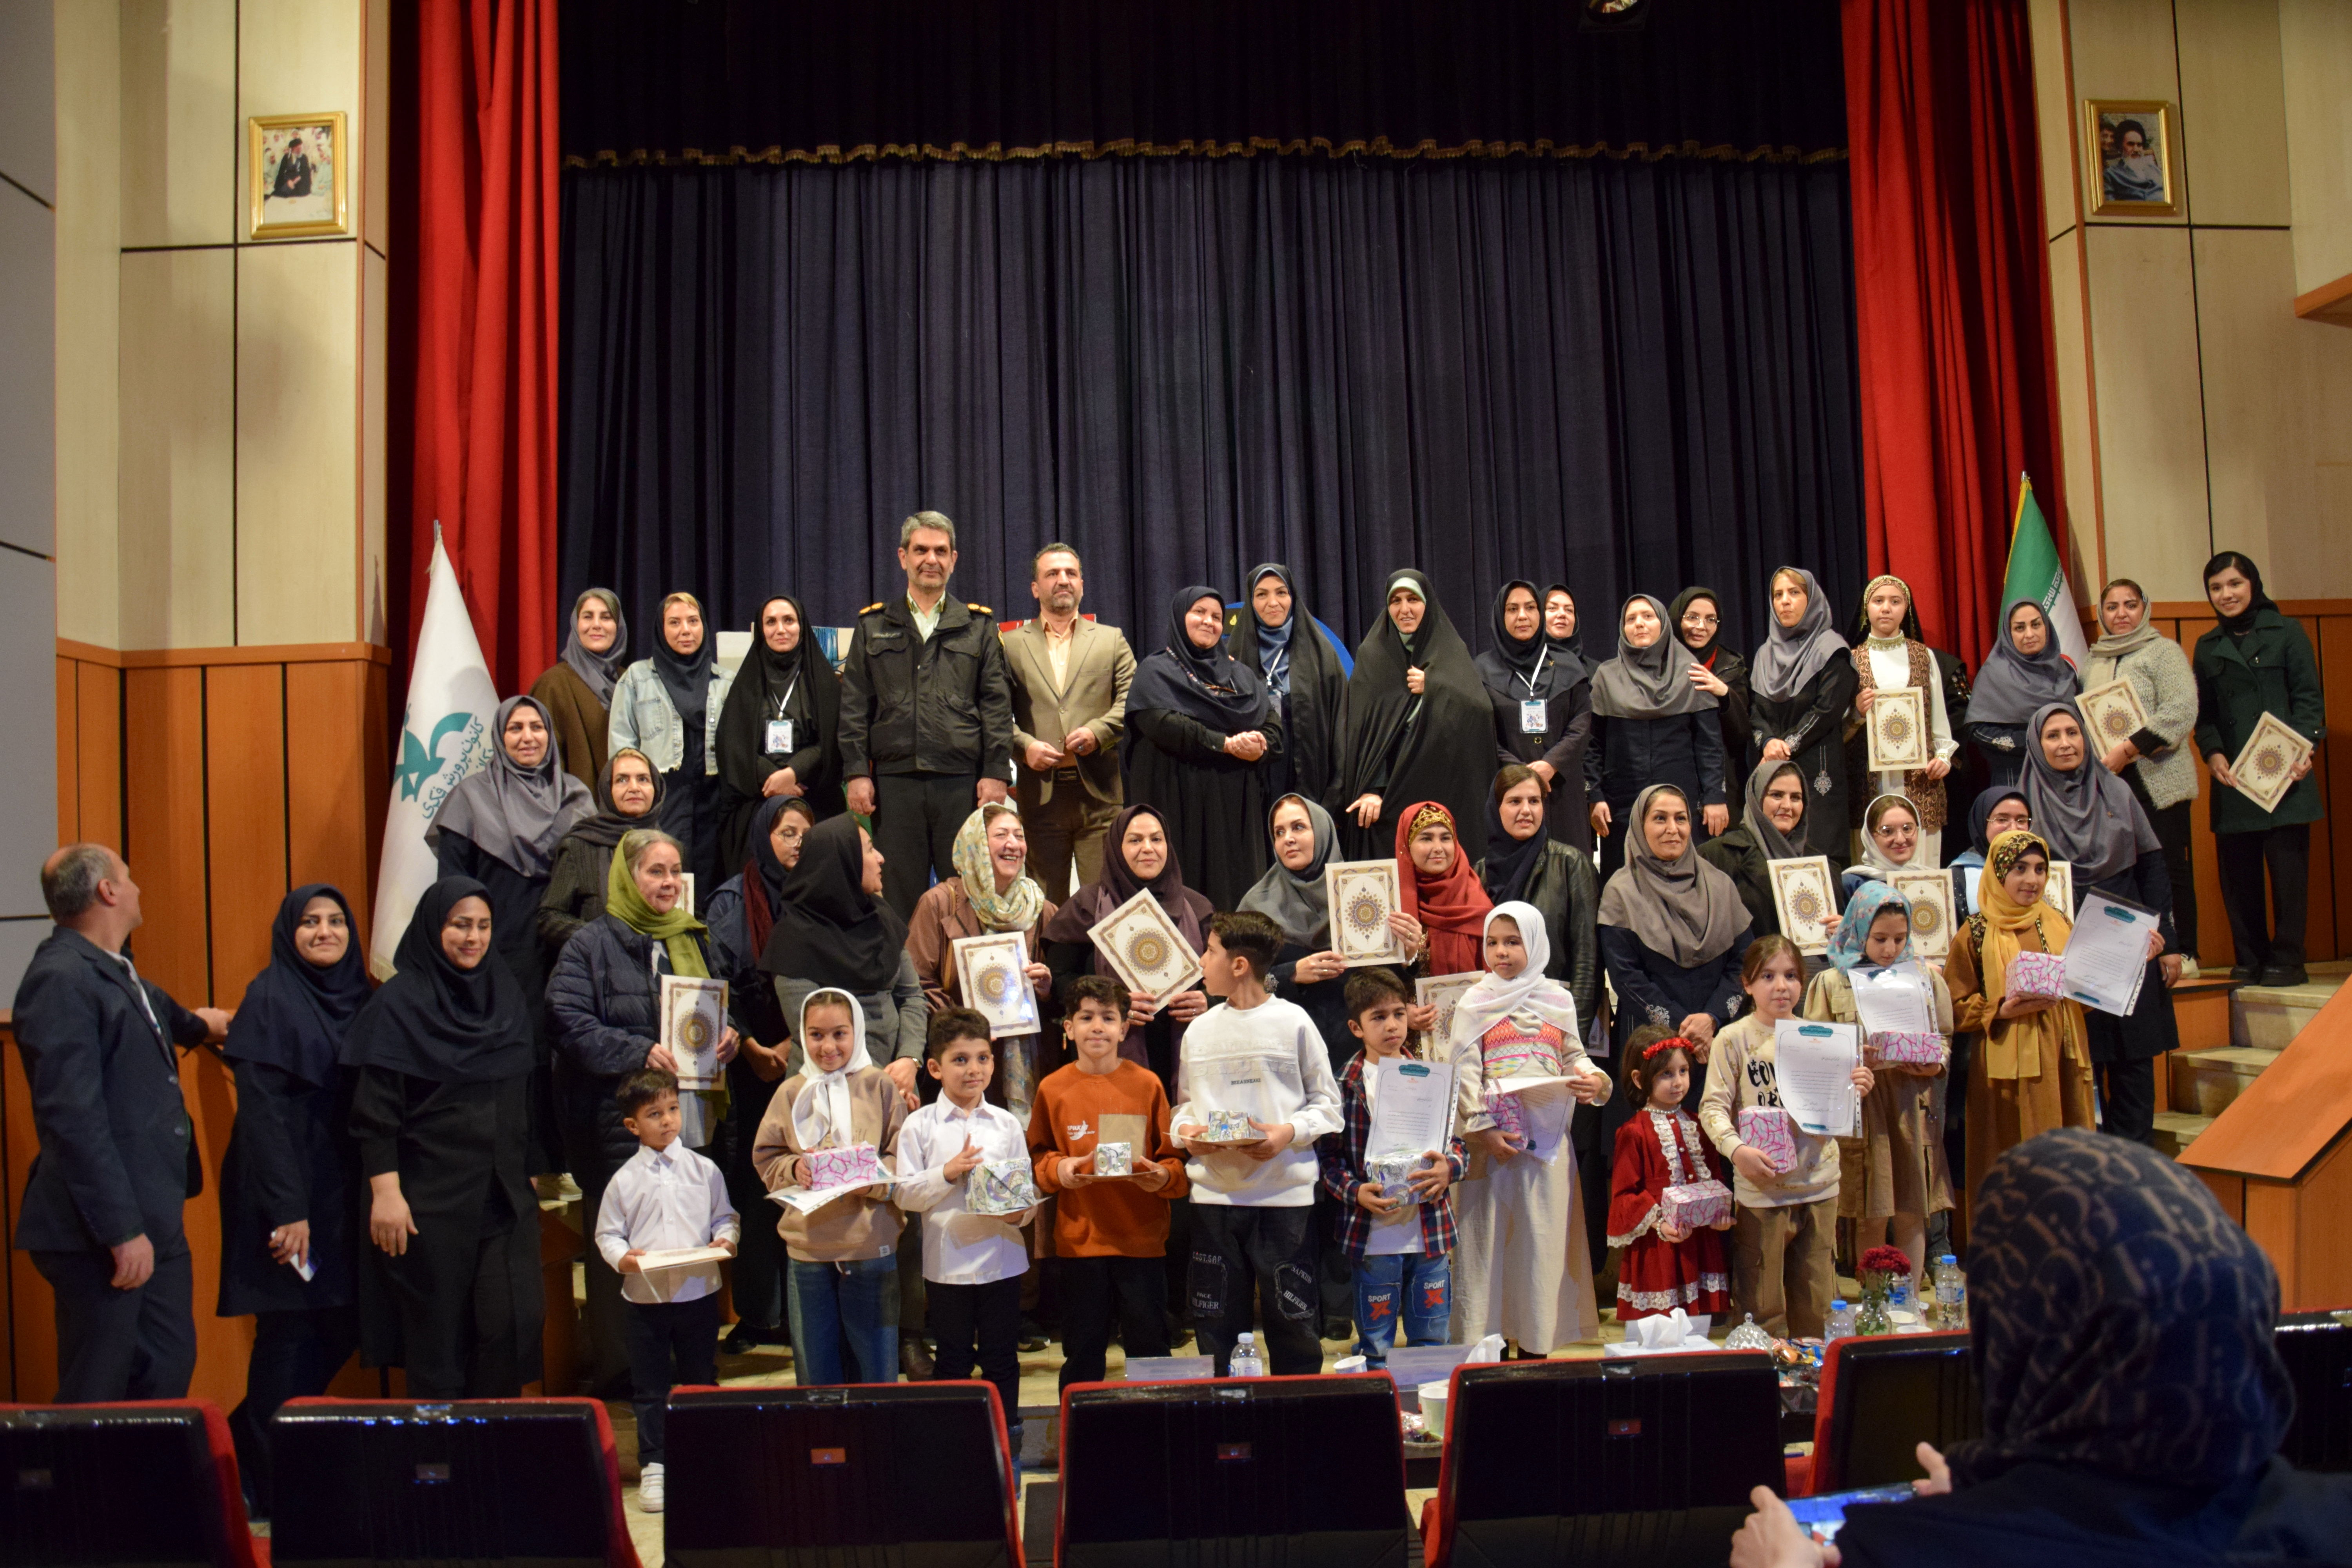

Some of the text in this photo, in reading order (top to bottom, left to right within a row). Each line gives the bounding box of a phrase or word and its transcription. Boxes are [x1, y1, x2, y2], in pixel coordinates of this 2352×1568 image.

[423, 716, 484, 819] کانون پرورش فکری
[1423, 1279, 1445, 1289] SPORT
[1283, 1290, 1307, 1311] HILFIGER
[1368, 1293, 1391, 1302] SPORT
